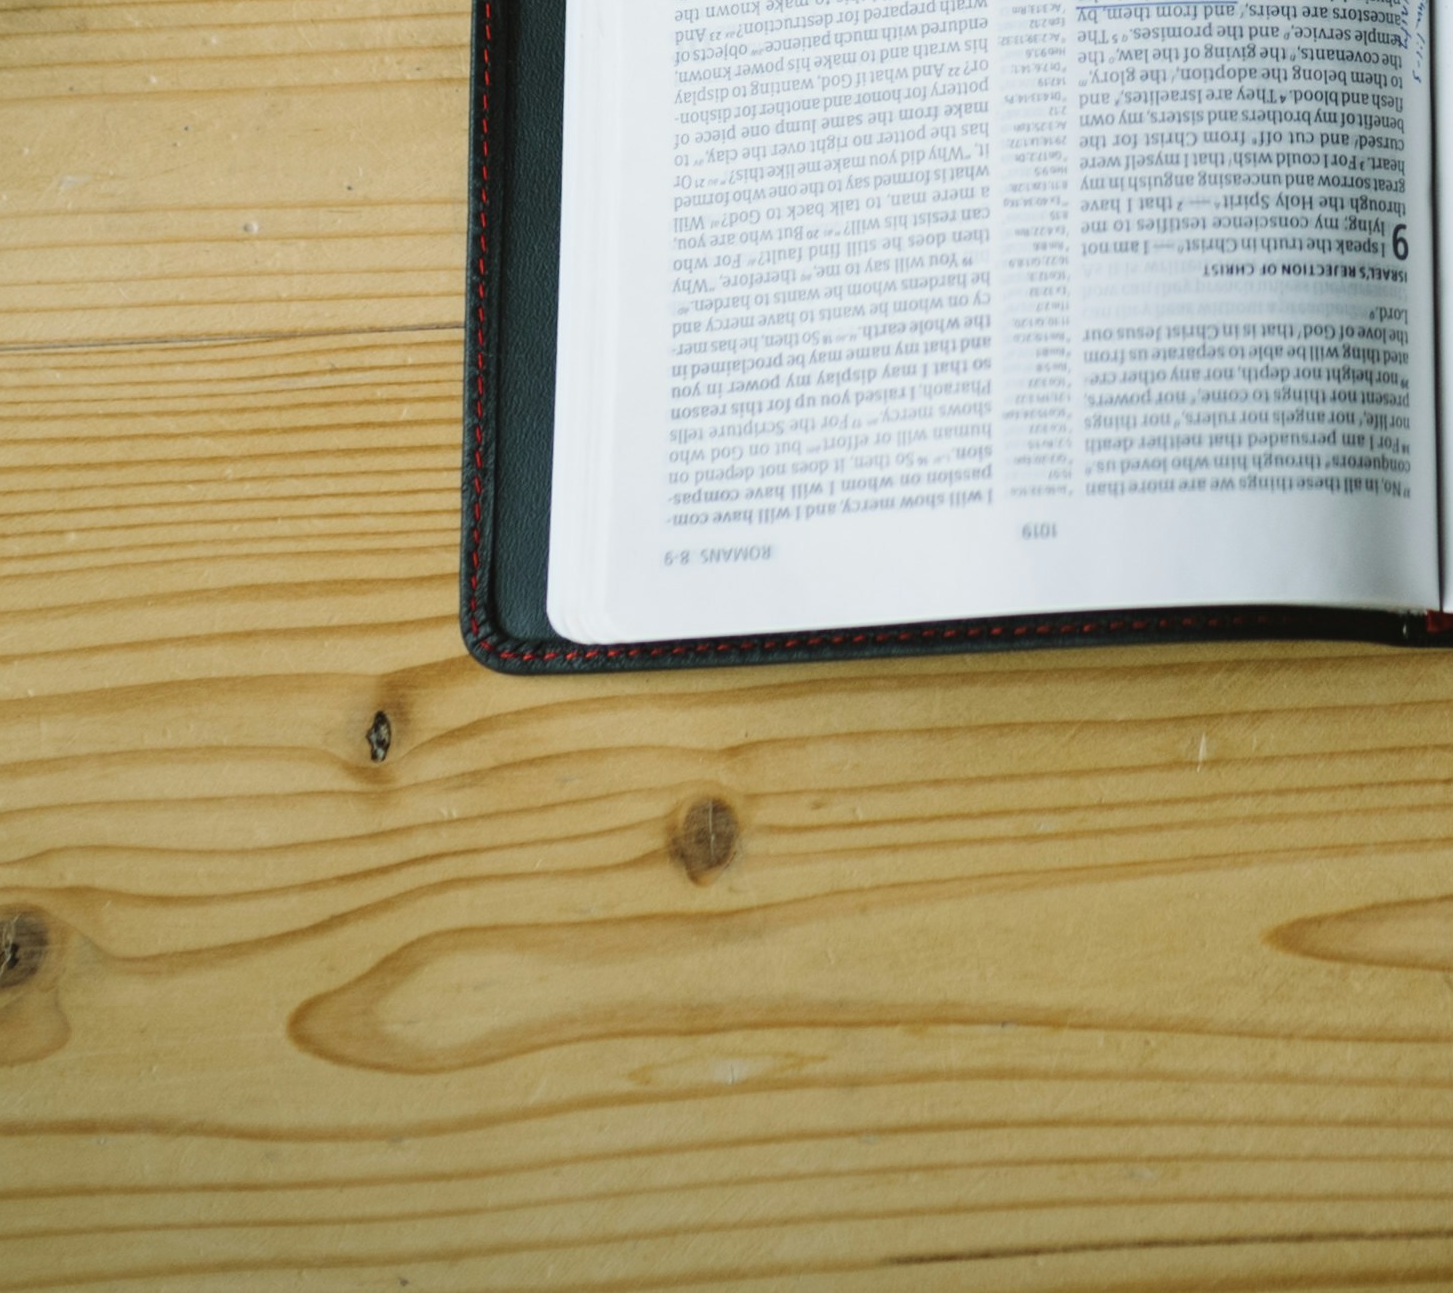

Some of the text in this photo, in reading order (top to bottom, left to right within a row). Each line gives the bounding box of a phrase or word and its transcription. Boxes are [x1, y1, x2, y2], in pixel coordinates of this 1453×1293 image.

[1081, 217, 1386, 238] lying; my conscience testifies to me
[1392, 224, 1408, 260] 9
[1204, 263, 1407, 282] ISRAEL'S REJECTION OF CHRIST
[1021, 522, 1059, 541] 1019
[664, 545, 773, 567] ROMANS 8-9
